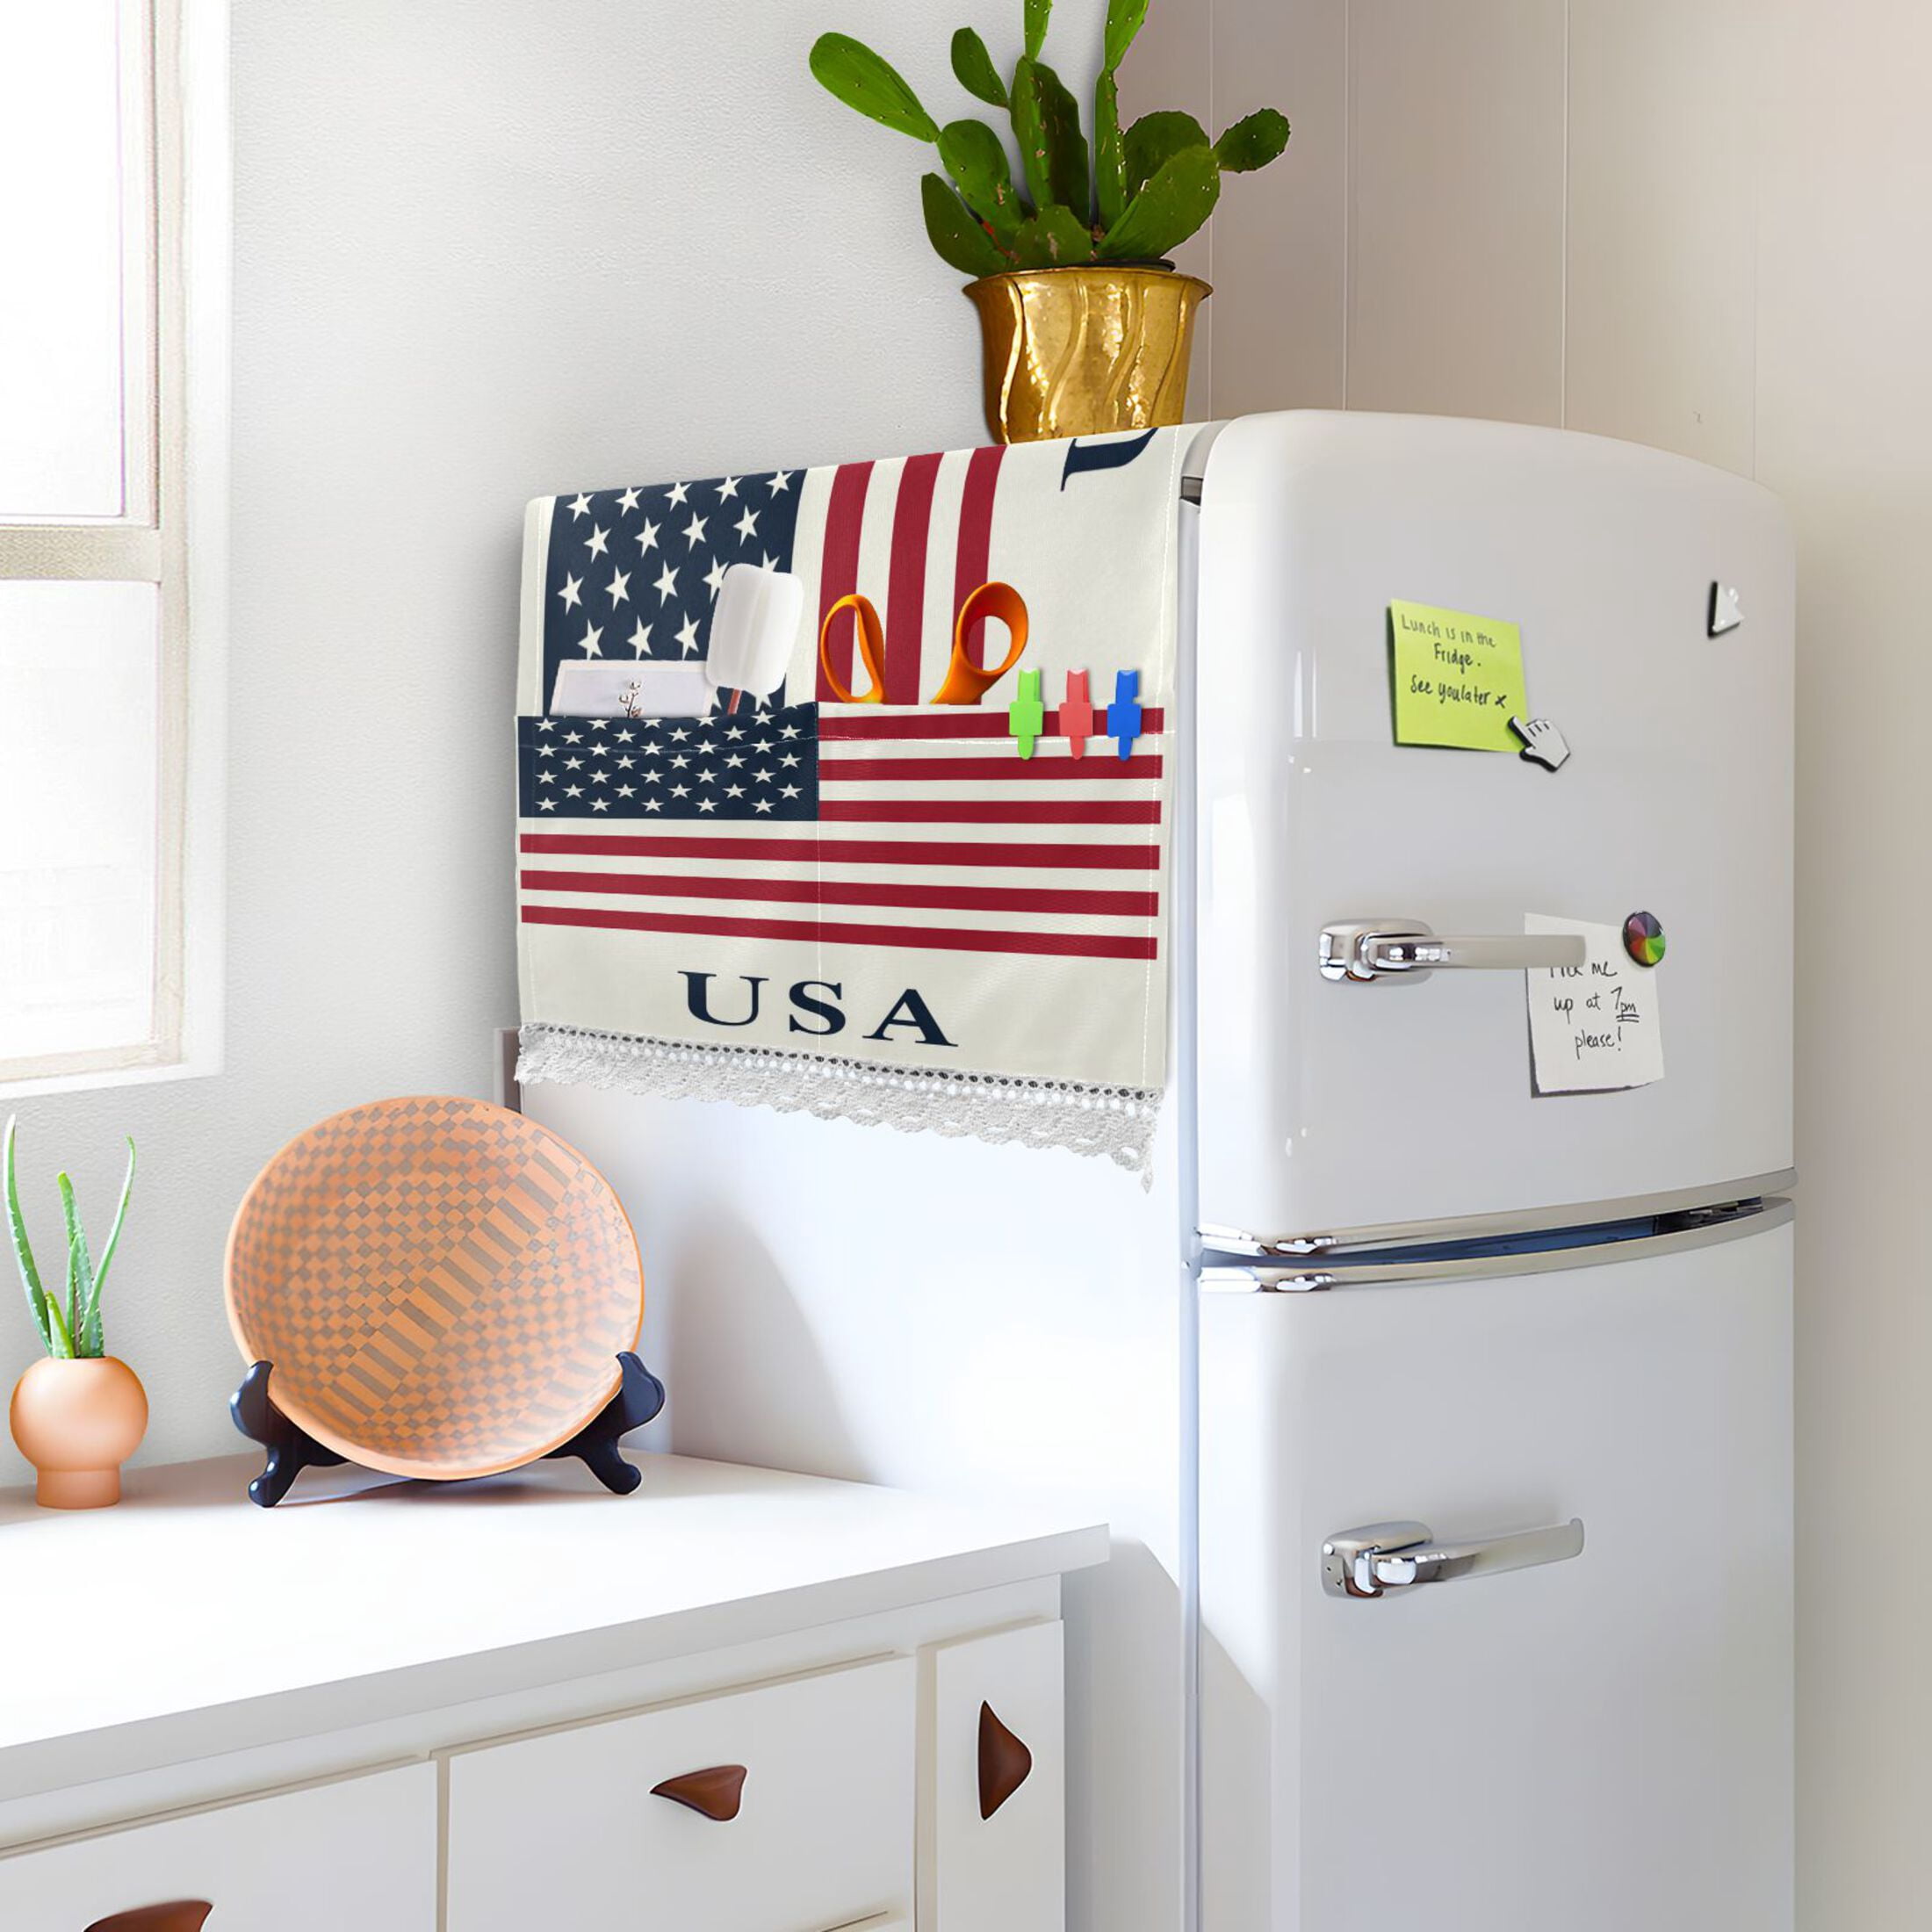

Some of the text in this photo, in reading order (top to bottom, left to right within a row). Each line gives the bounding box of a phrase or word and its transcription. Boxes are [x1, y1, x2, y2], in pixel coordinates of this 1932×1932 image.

[1402, 614, 1496, 648] Lunch is in the
[1410, 674, 1433, 695] See
[677, 970, 959, 1048] USA
[1554, 996, 1574, 1024] up
[1586, 991, 1601, 1011] at
[1575, 1026, 1622, 1061] please!
